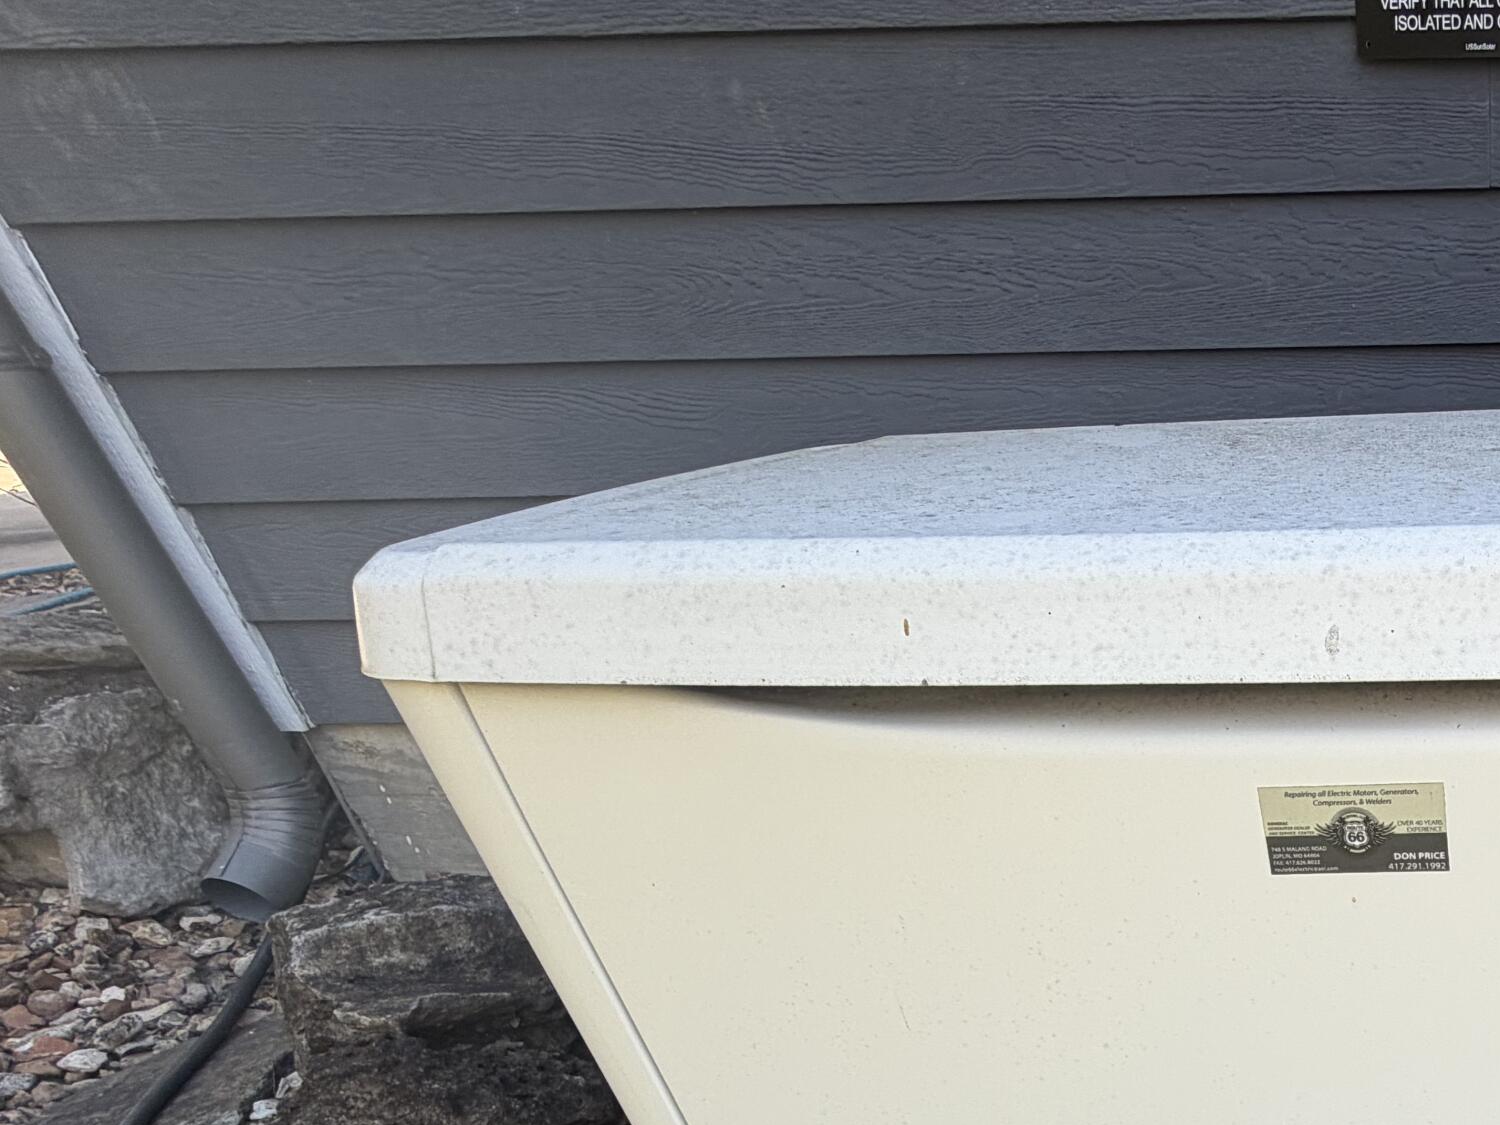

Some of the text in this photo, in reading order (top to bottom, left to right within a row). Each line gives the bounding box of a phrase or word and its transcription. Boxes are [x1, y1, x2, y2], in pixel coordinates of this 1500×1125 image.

[1381, 0, 1427, 10] VERIFY
[1433, 0, 1466, 9] THAT
[1468, 0, 1494, 8] ALL
[1394, 14, 1462, 31] ISOLATED
[1463, 13, 1494, 30] AND
[1283, 791, 1317, 799] Repairing
[1365, 797, 1392, 805] Welders
[1347, 831, 1365, 842] 66
[1393, 851, 1446, 860] DON PRICE
[1388, 861, 1447, 870] 417.291.1992
